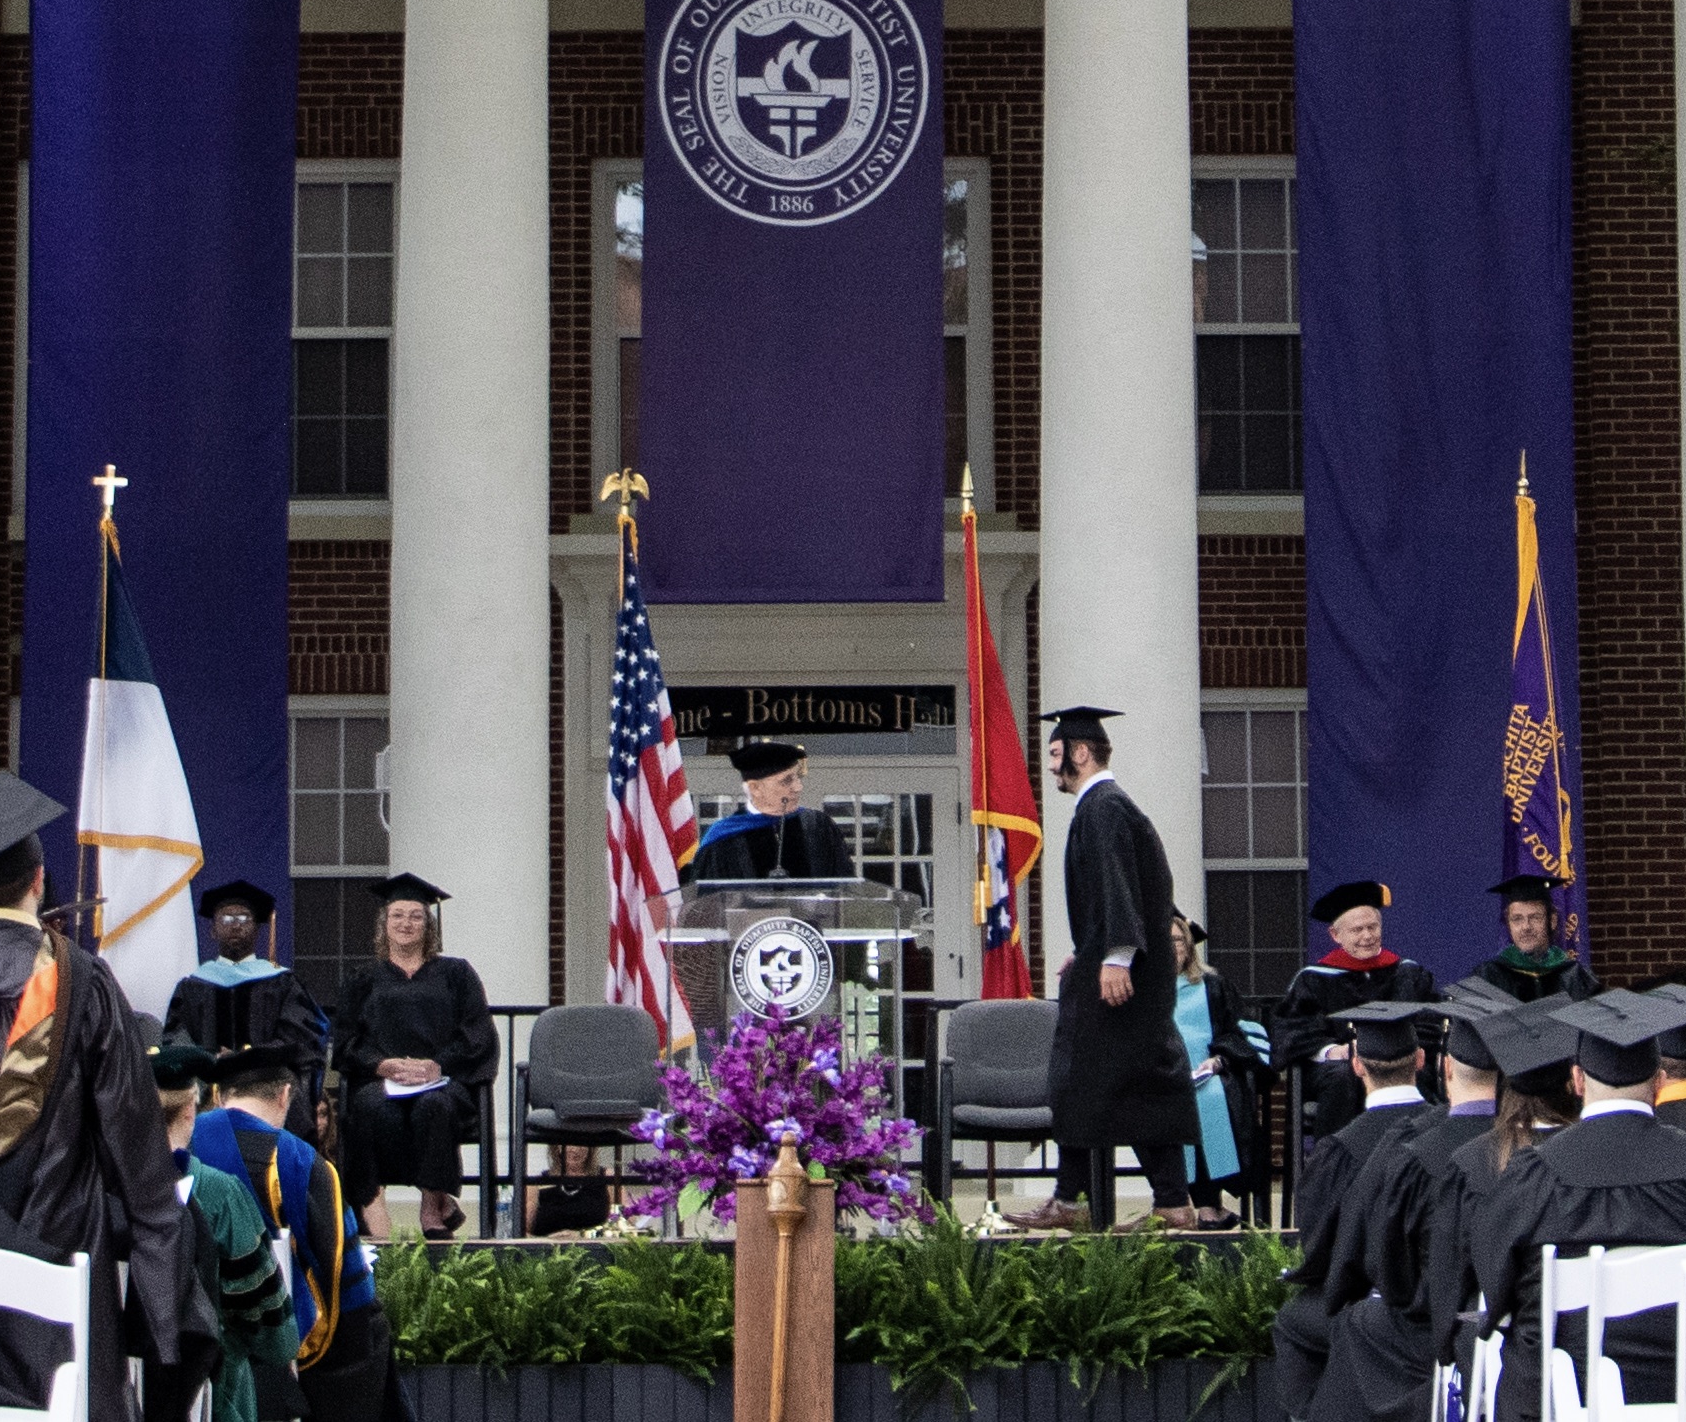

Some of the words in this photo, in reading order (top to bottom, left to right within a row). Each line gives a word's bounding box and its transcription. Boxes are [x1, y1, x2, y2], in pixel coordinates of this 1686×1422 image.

[672, 37, 696, 75] OF
[712, 52, 732, 125] VISION
[854, 48, 876, 128] SERVICE
[672, 87, 705, 151] SEAL
[833, 64, 916, 207] UNIVERSITY
[702, 155, 749, 204] THE
[769, 194, 815, 215] 1886
[746, 688, 883, 727] Bottoms
[1505, 715, 1541, 799] BAPTIST
[792, 923, 825, 955] BAPTIST
